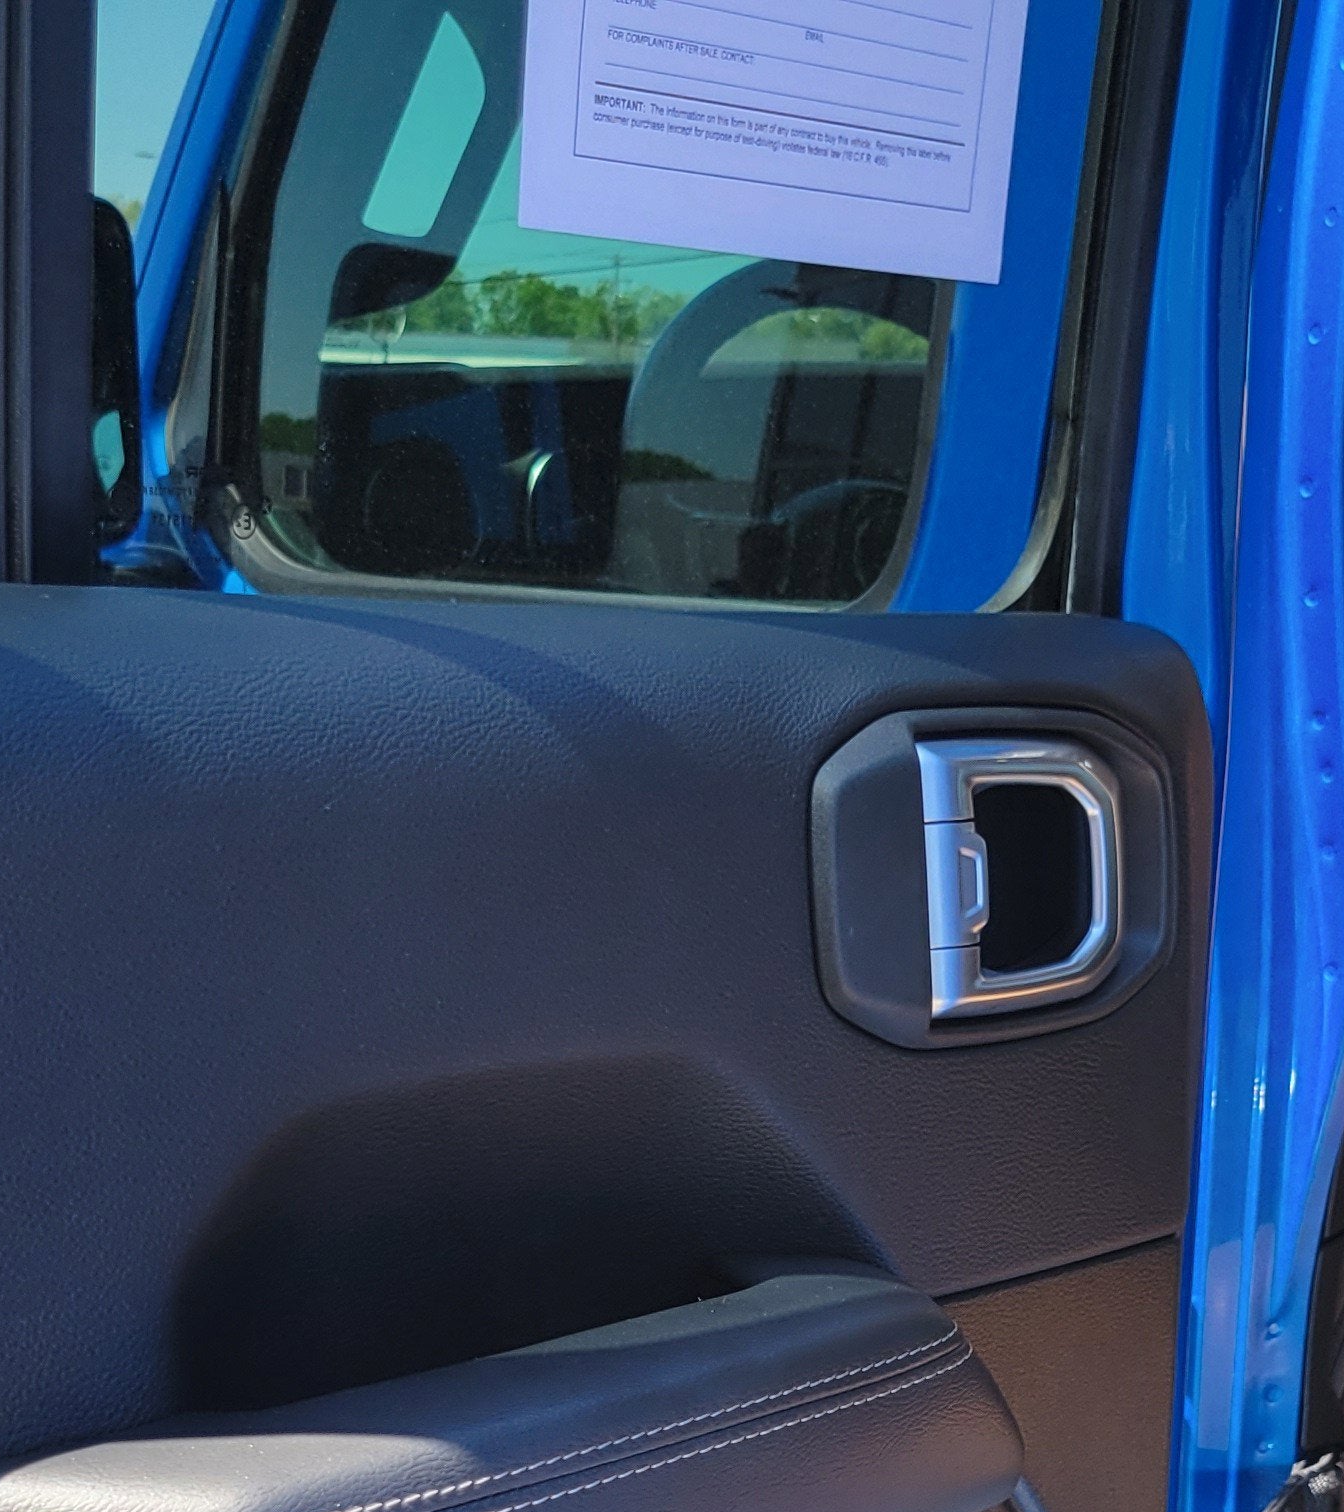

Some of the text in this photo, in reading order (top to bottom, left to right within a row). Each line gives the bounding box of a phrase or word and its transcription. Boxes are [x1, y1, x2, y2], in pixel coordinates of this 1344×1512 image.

[608, 29, 625, 40] FOR
[625, 32, 674, 51] COMPLAINTS
[675, 41, 699, 55] AFTER
[593, 112, 630, 127] consumer
[694, 126, 704, 137] for
[594, 94, 646, 113] IMPORTANT:
[650, 103, 665, 116] The
[707, 115, 716, 123] on
[717, 114, 729, 126] this
[777, 126, 789, 137] any
